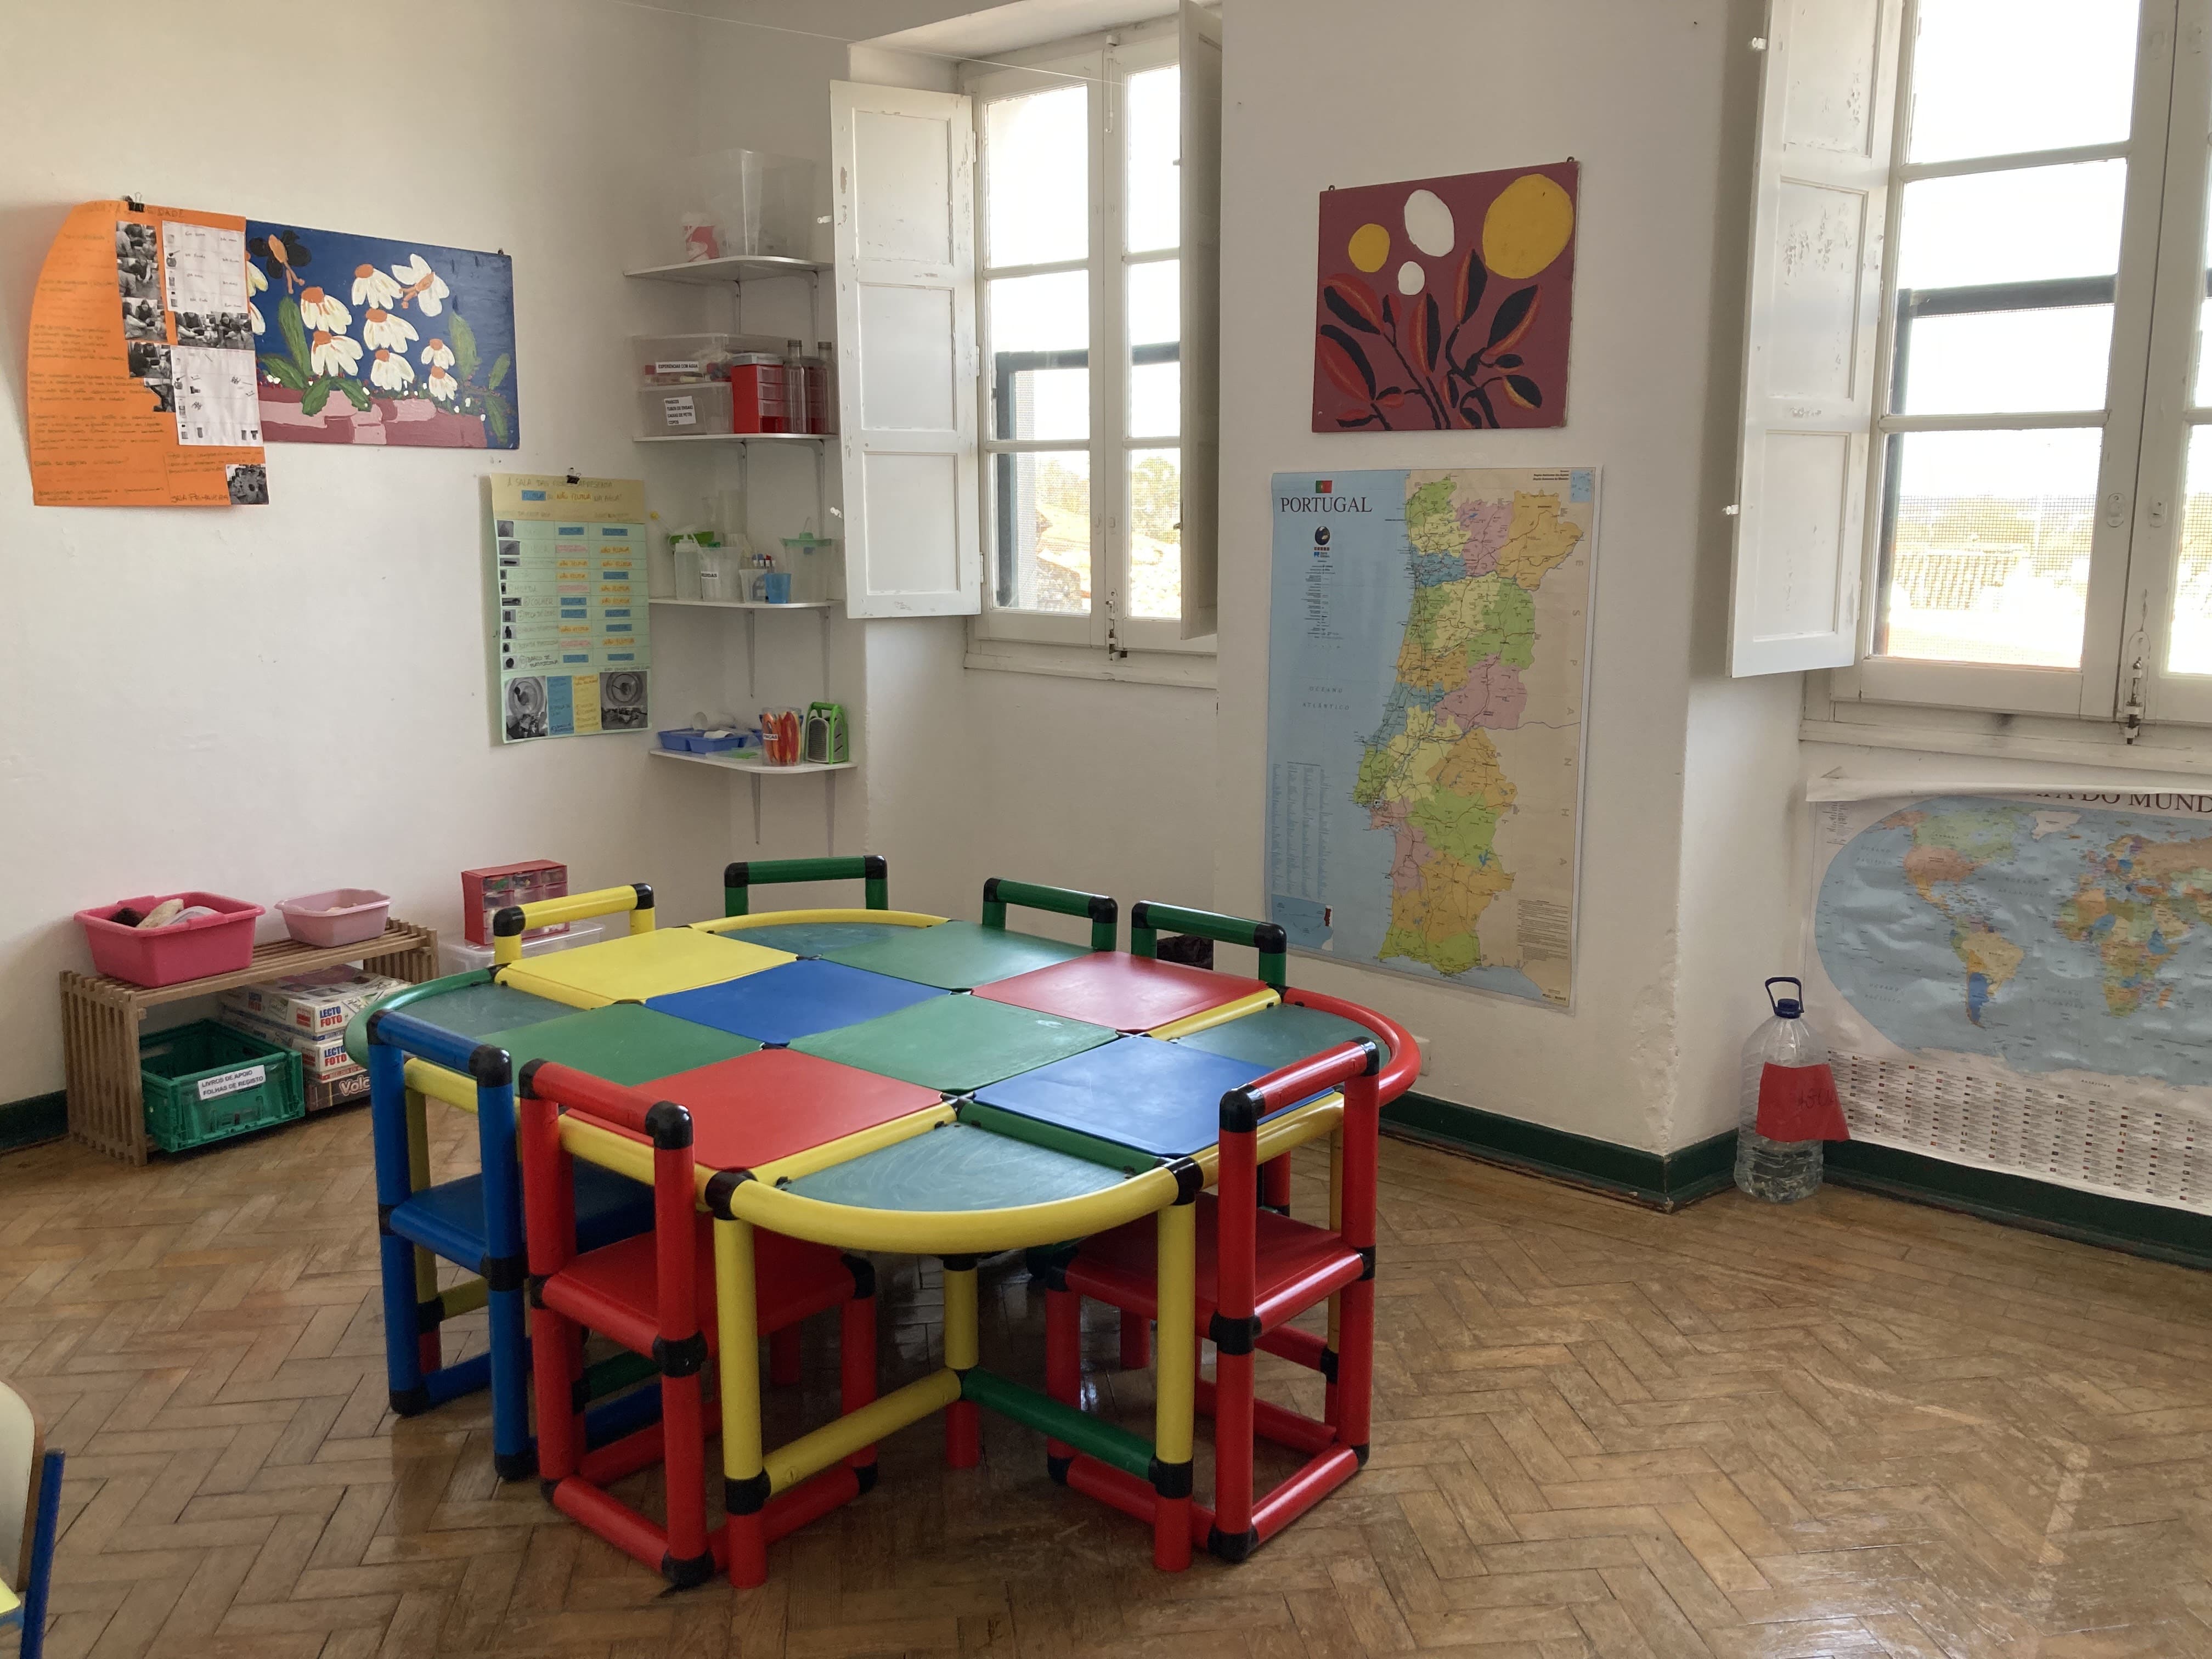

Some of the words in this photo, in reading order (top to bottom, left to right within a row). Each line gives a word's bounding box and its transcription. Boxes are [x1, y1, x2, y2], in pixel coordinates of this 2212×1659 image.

[1280, 496, 1373, 513] PORTUGAL
[319, 1006, 341, 1019] LECTO
[320, 1014, 343, 1028] FOTO
[324, 1045, 347, 1058] LECTO
[325, 1053, 347, 1066] FOTO
[201, 1077, 224, 1087] LIVROS
[234, 1070, 253, 1079] APOIO
[203, 1086, 228, 1096] FOLHAS
[238, 1075, 264, 1087] REGISTO
